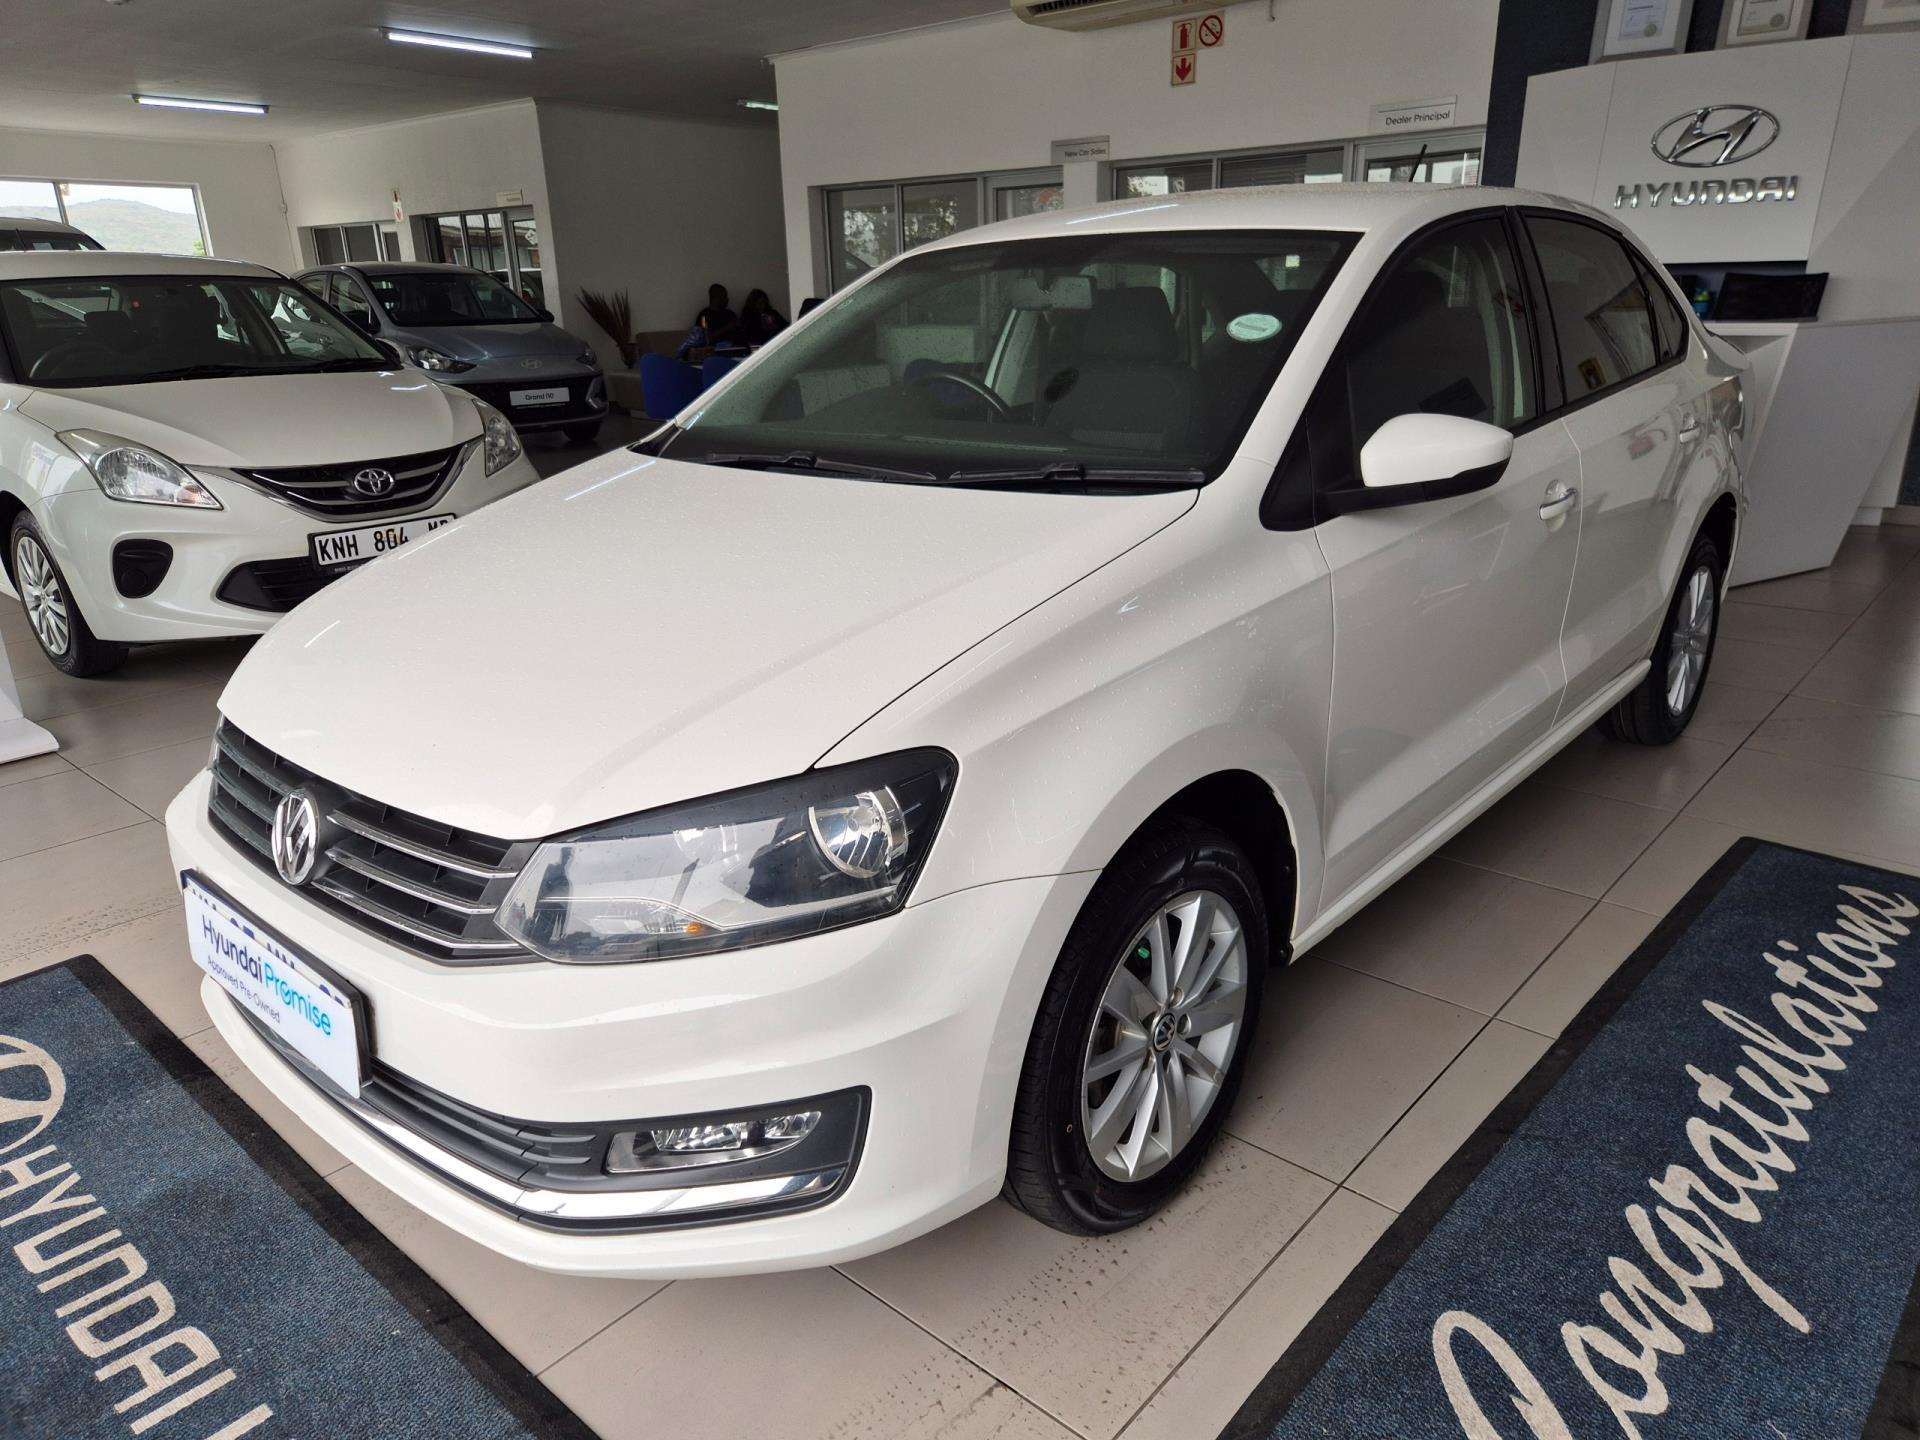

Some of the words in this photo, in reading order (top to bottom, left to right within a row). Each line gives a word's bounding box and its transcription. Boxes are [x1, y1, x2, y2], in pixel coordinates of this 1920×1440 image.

[1385, 115, 1413, 126] Dealer
[1414, 109, 1451, 123] Principal
[1614, 175, 1799, 209] HYUNDAI
[318, 534, 359, 562] KNH
[373, 526, 409, 552] 804
[202, 914, 263, 984] Hyundai
[263, 962, 332, 1036] Promise
[207, 955, 245, 989] Approved
[239, 980, 281, 1024] Pre-Owned
[0, 1144, 237, 1435] HYUNDAI
